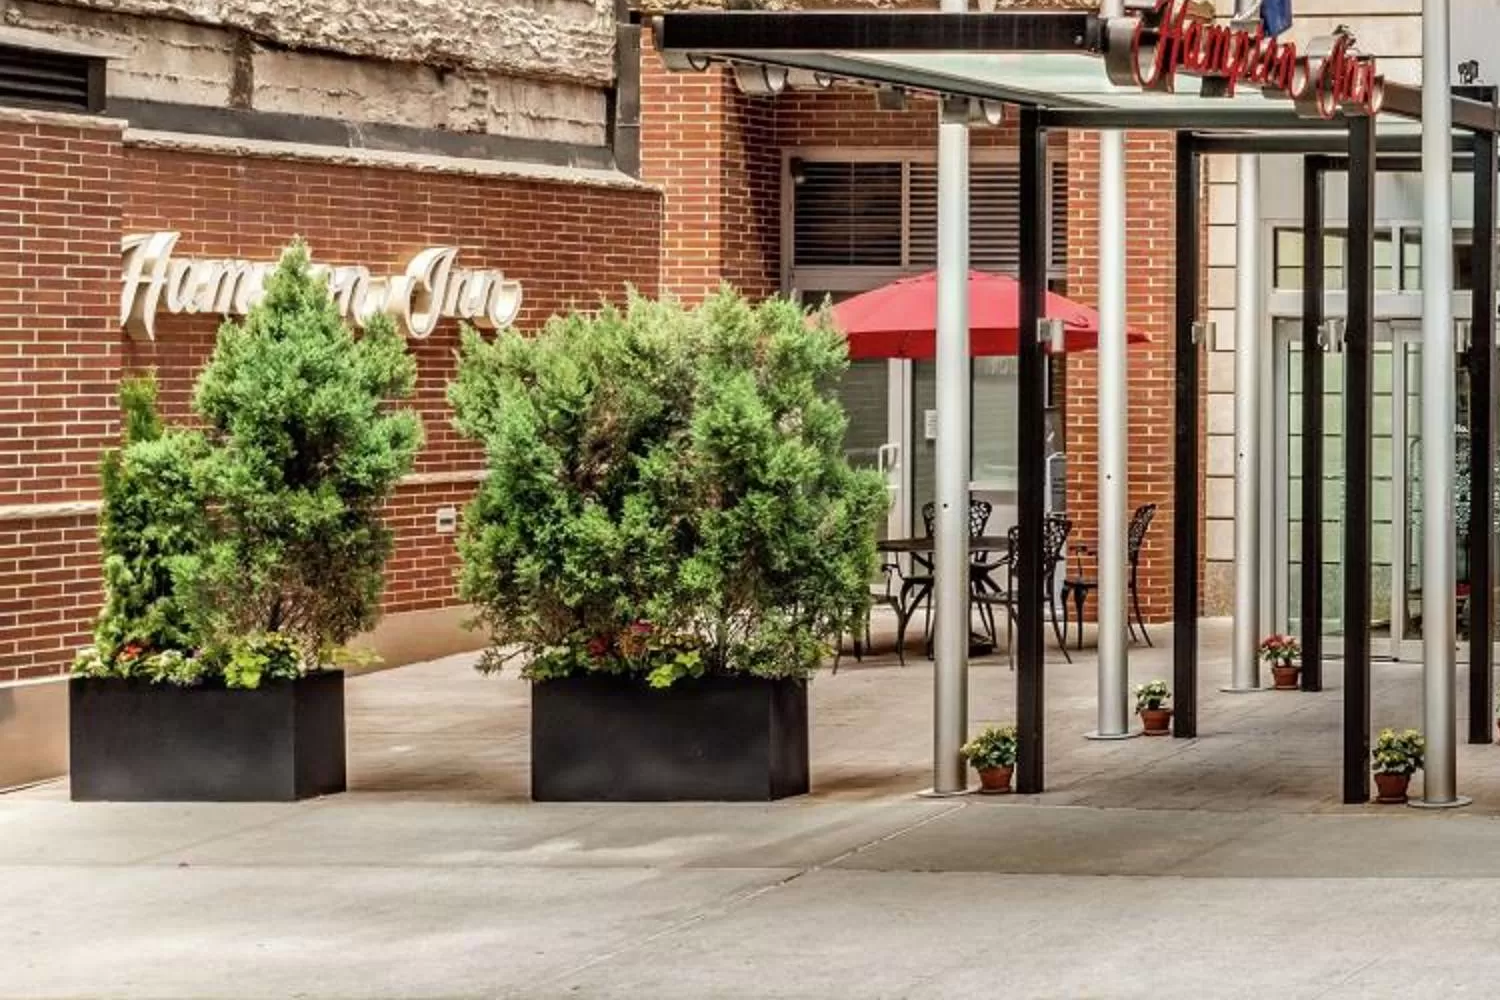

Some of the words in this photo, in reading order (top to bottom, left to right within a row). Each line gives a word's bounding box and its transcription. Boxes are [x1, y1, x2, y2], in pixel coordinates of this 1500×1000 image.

[1317, 34, 1385, 120] Inn
[121, 231, 390, 341] Hamn
[404, 246, 523, 339] Inn
